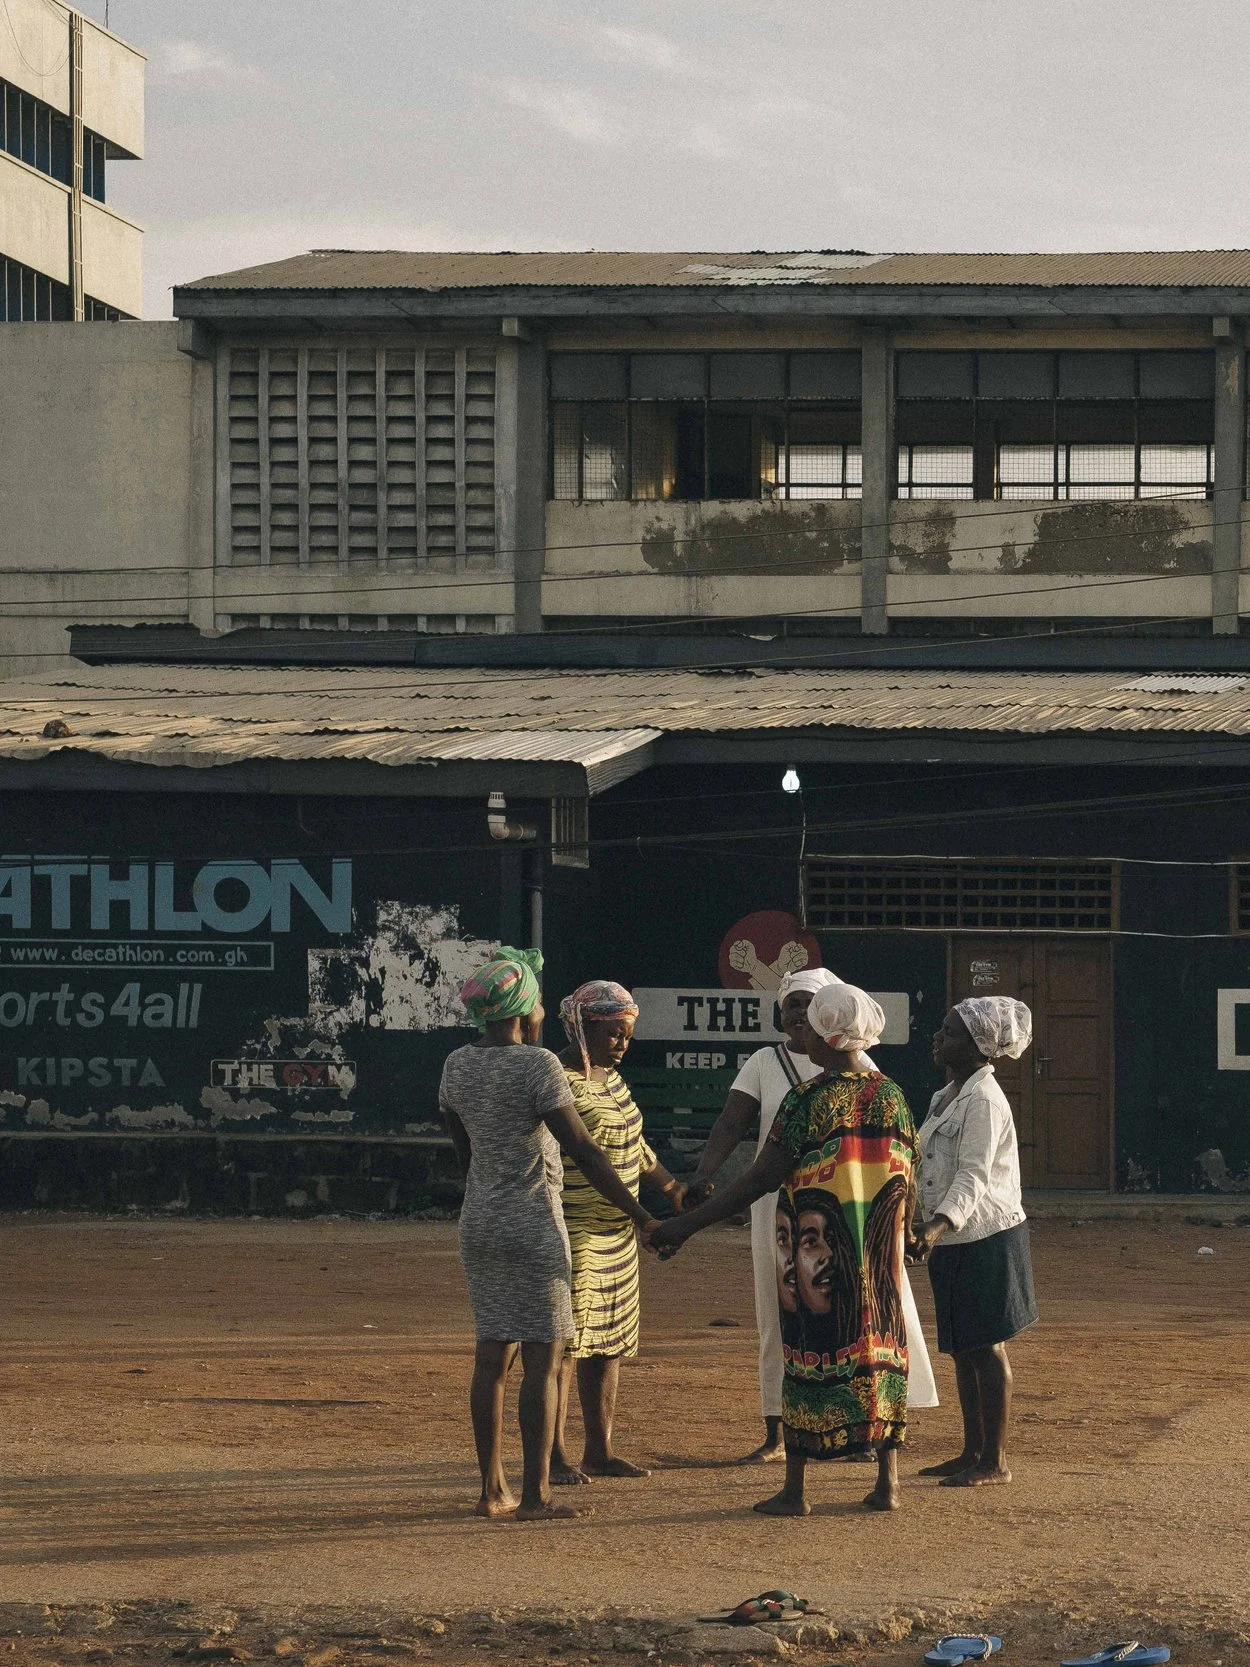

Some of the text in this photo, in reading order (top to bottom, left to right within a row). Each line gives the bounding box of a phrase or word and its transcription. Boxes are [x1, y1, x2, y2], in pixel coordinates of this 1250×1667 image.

[677, 996, 761, 1032] THE
[17, 1057, 166, 1088] KIPSTA
[665, 1052, 726, 1069] KEEP
[218, 1064, 356, 1089] THE GYM
